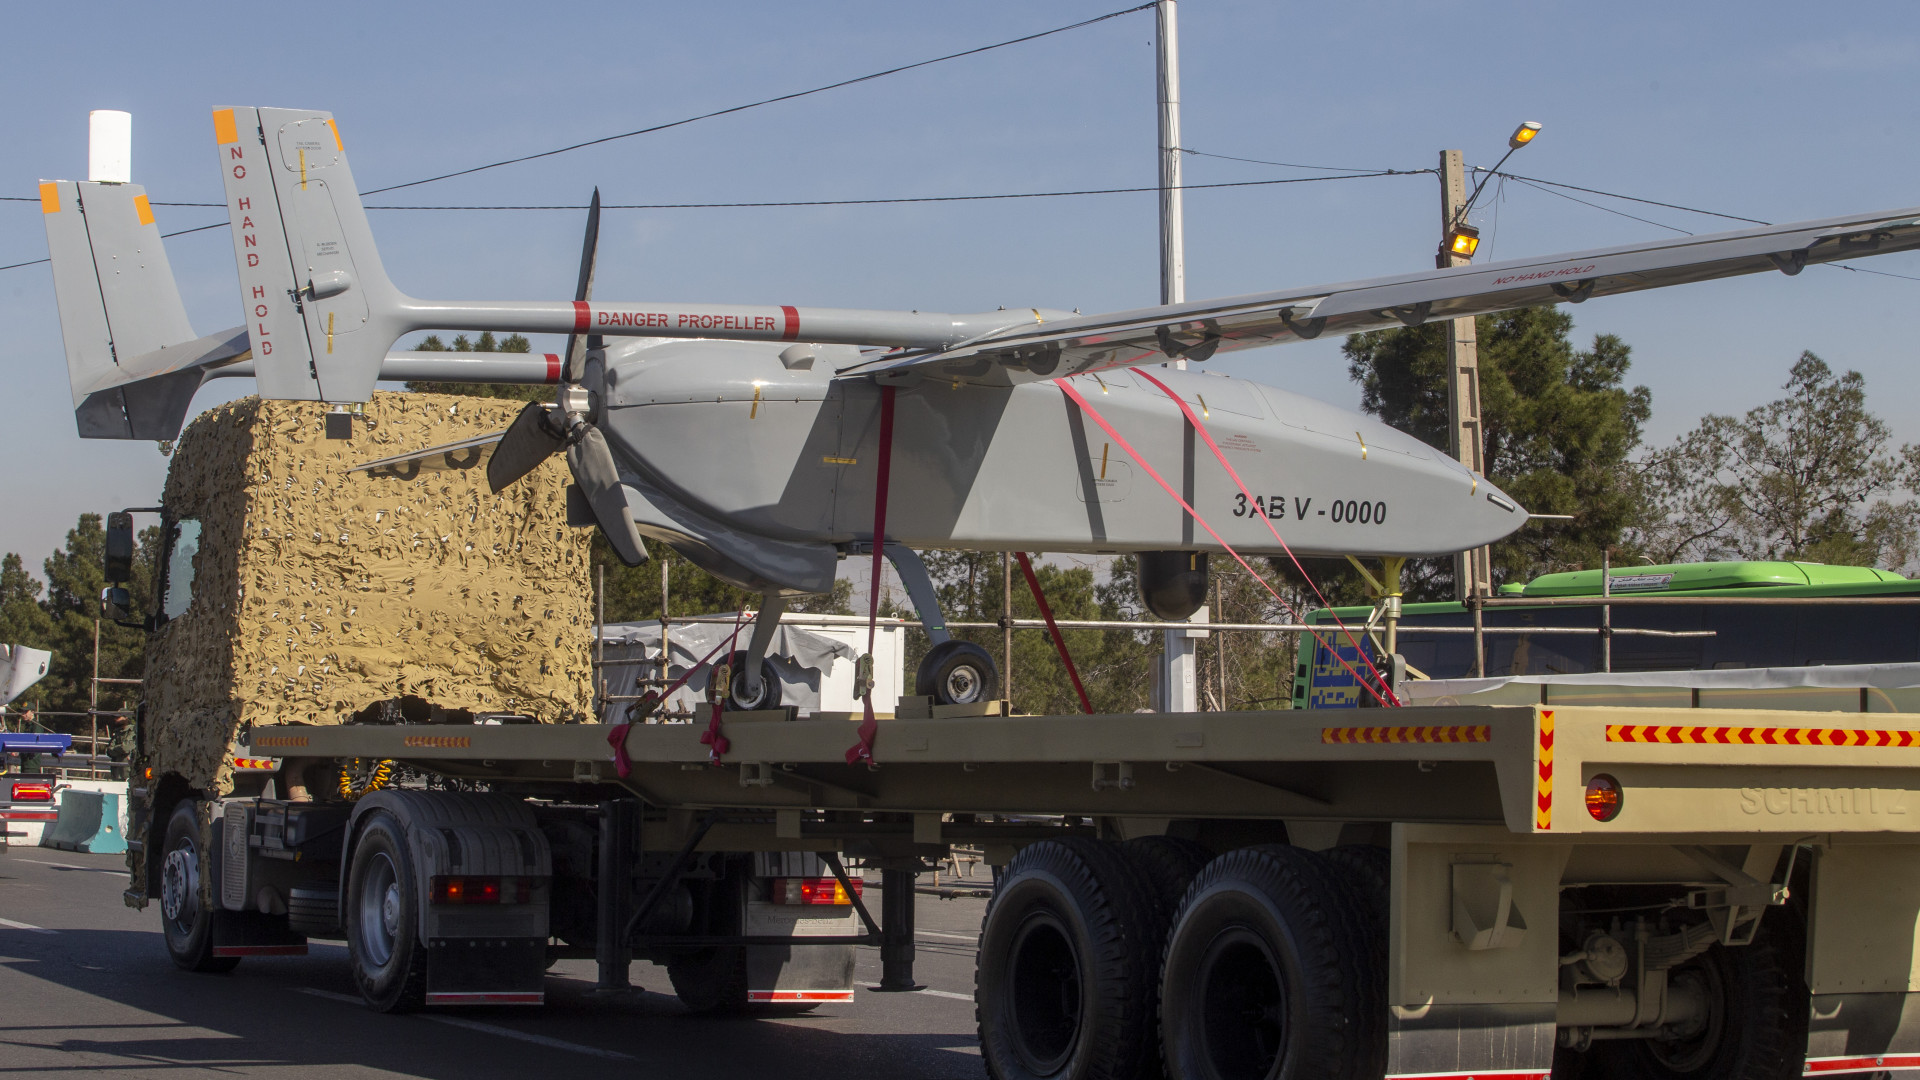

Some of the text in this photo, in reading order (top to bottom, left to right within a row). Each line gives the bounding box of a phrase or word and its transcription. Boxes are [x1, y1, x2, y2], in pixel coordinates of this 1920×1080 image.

[231, 147, 273, 356] NO HAND HOLD
[1492, 264, 1596, 285] NO HAND HOLD
[598, 311, 776, 331] DANGER PROPELLER
